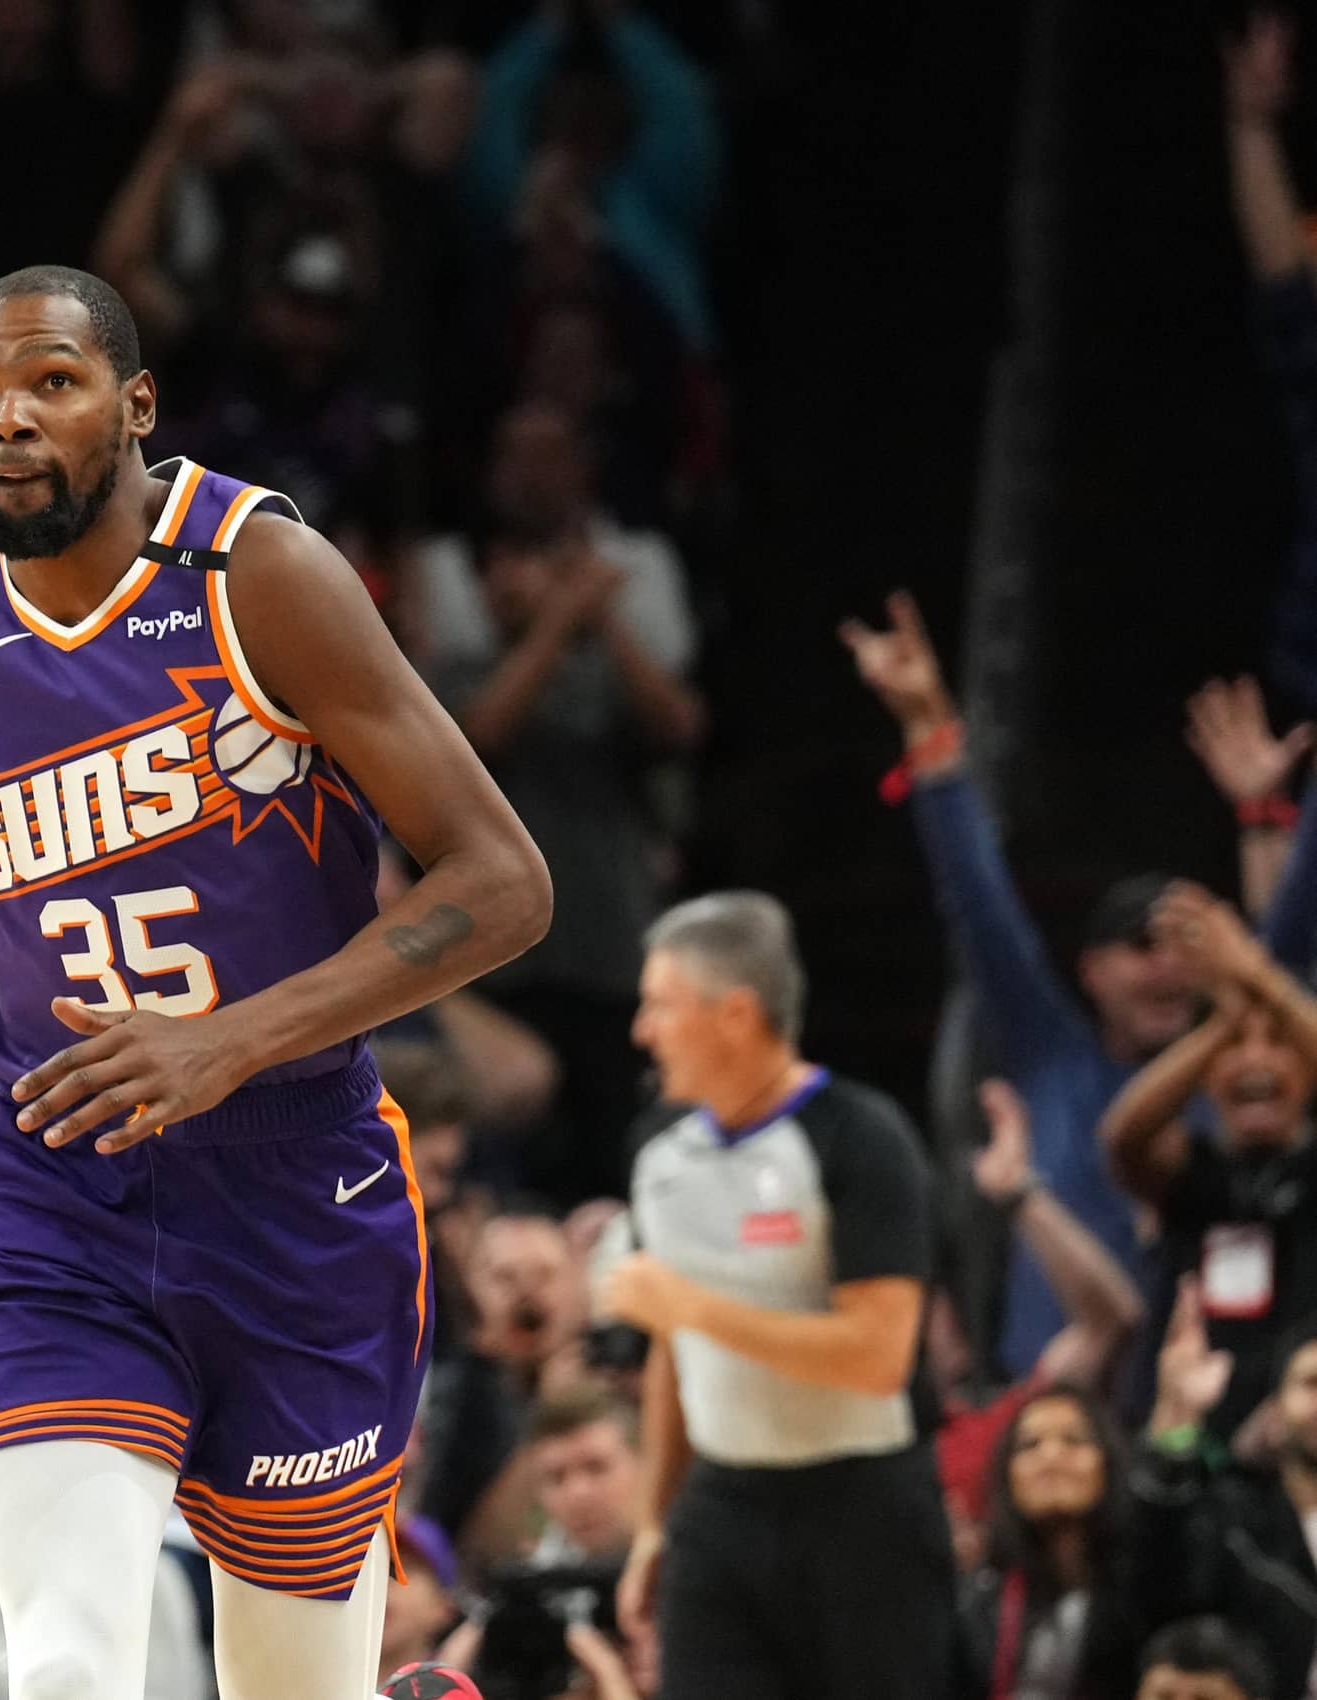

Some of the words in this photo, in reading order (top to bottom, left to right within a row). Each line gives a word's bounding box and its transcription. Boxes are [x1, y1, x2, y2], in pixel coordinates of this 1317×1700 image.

[178, 550, 193, 566] AL
[127, 606, 202, 640] PayPal
[39, 886, 219, 1017] 35
[245, 1424, 382, 1487] PHOENIX
